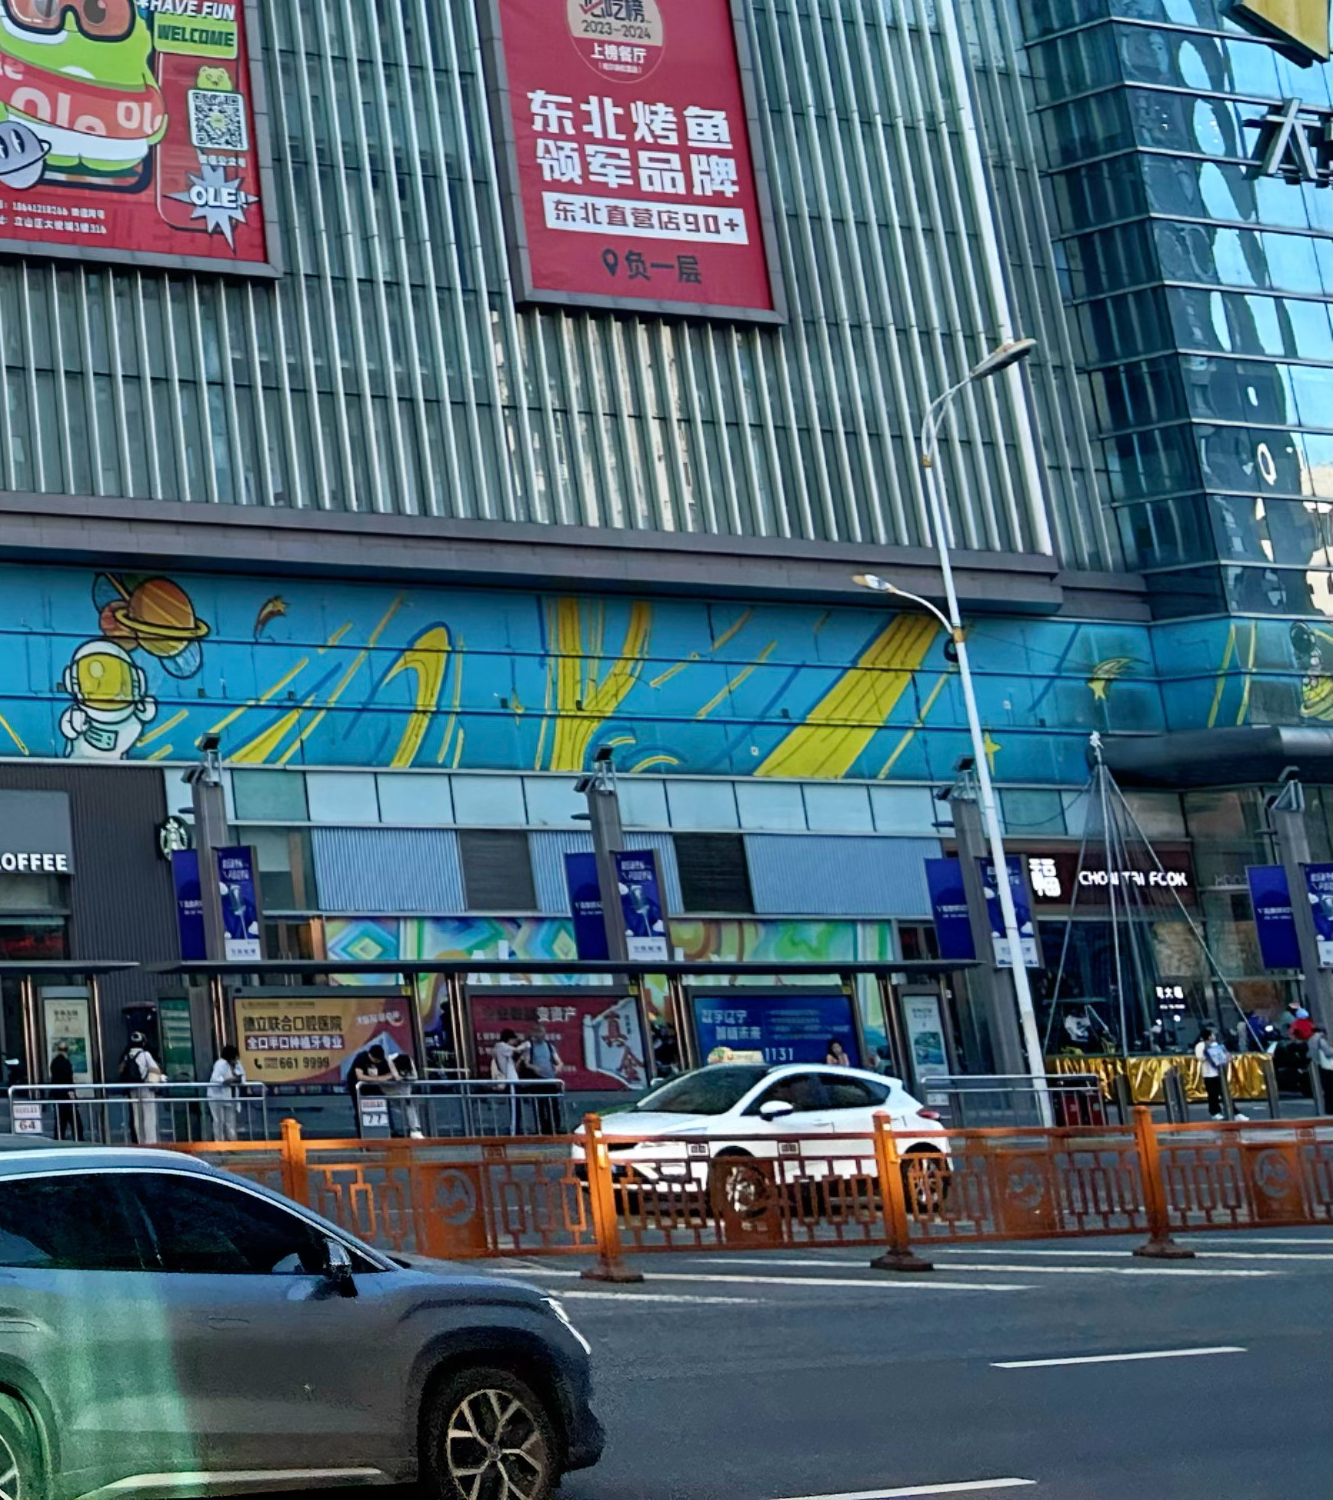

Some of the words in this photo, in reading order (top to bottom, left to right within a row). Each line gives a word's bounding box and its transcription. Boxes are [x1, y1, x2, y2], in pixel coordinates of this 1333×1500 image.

[201, 1, 236, 21] FUN
[157, 23, 235, 48] WELCOME
[590, 42, 648, 64] 上榜餐厅
[526, 89, 733, 151] 东北烤鱼
[535, 137, 740, 199] 领军品牌
[552, 198, 741, 237] 东北直营店90+
[624, 247, 703, 286] 负一层
